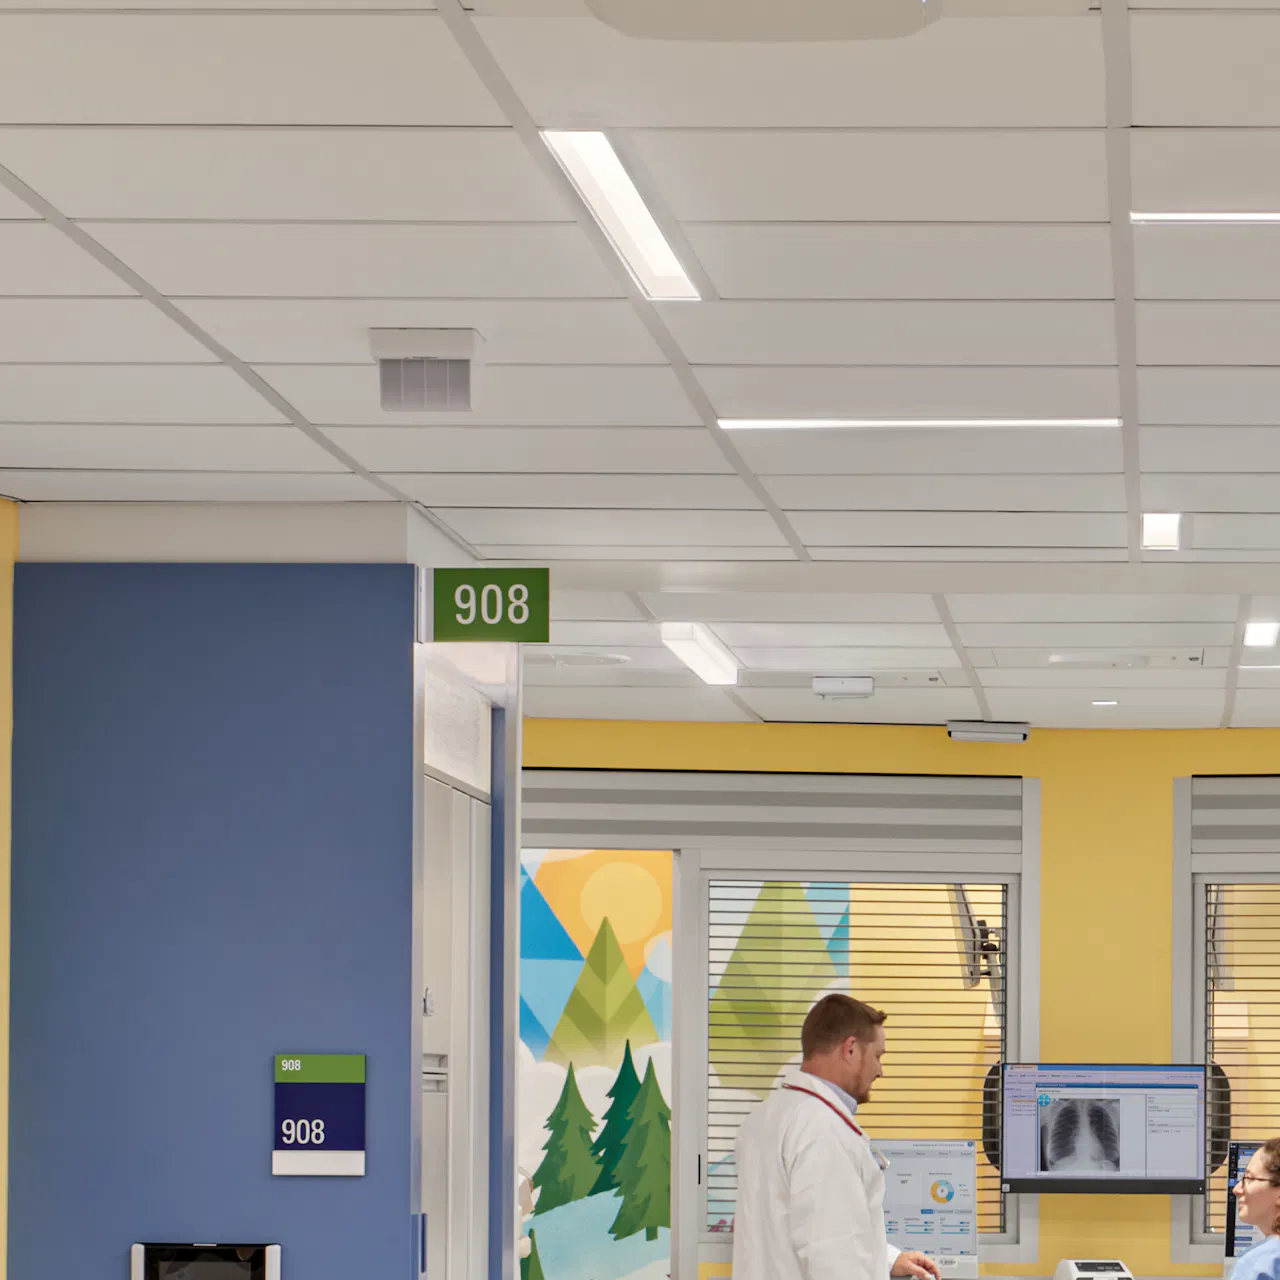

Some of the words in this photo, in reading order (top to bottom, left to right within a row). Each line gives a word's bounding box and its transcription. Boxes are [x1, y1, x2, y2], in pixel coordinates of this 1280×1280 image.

[454, 584, 530, 625] 908
[281, 1059, 302, 1072] 908
[281, 1118, 325, 1145] 908
